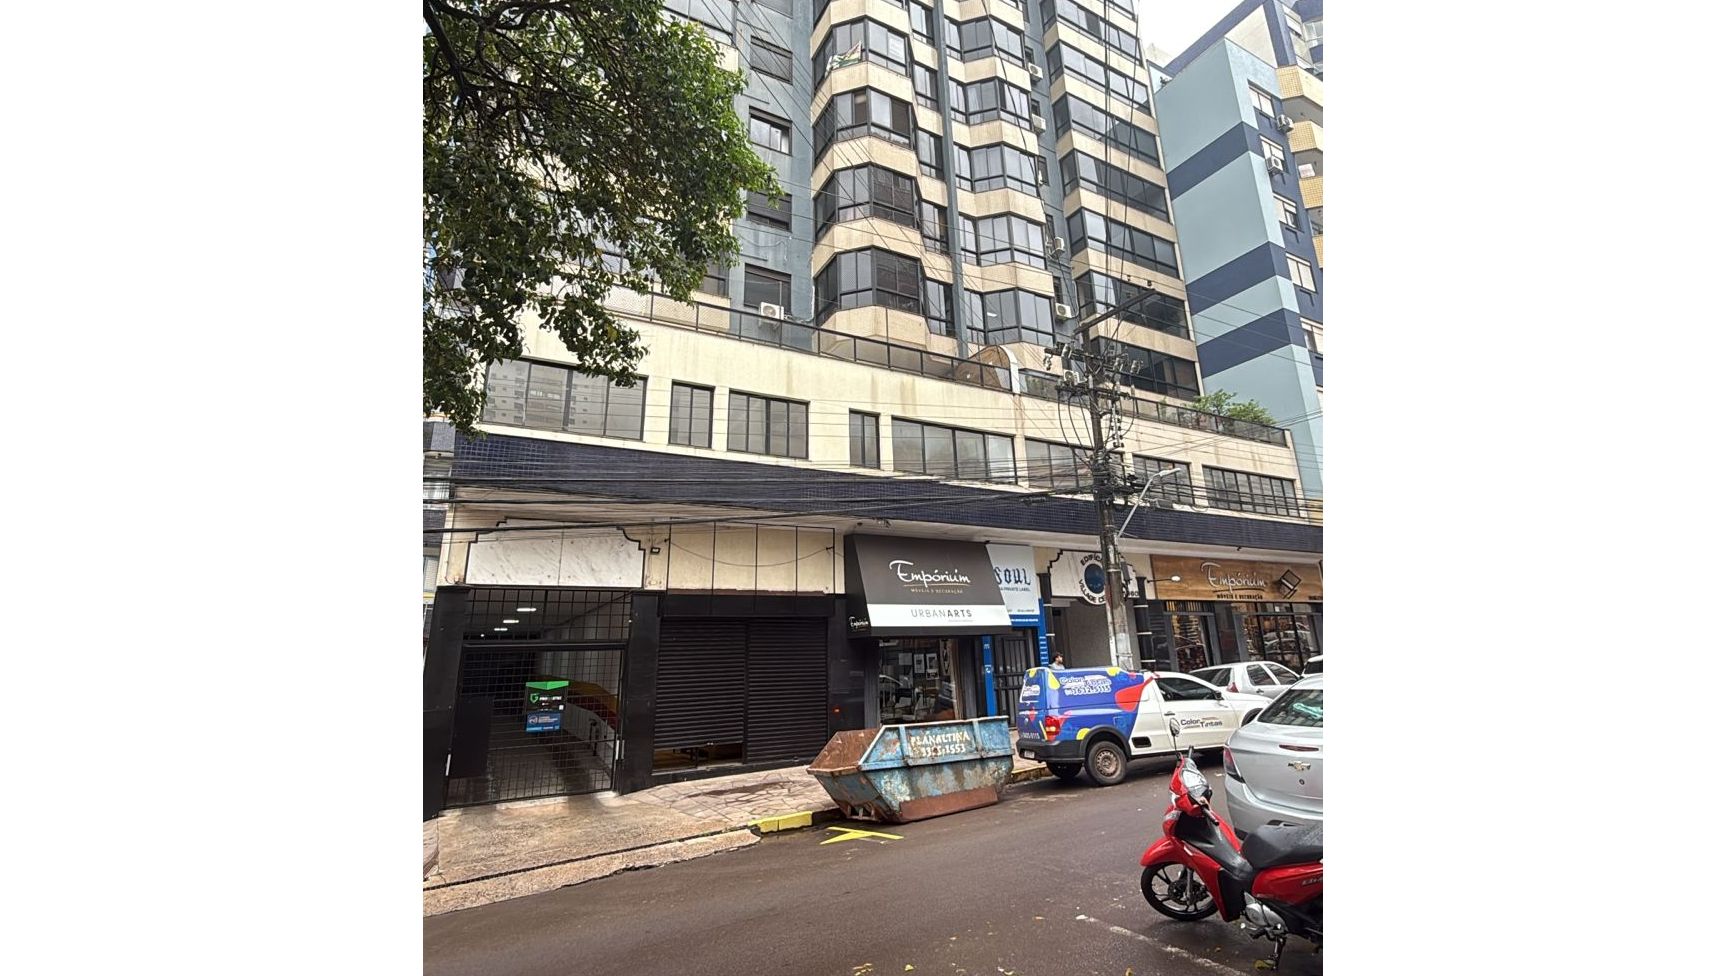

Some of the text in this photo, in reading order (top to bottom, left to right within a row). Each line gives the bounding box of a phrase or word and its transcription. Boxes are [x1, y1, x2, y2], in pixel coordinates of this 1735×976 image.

[994, 566, 1031, 585] SOUL
[1079, 579, 1097, 603] VILLAGE
[1200, 720, 1222, 728] Tintas
[911, 731, 970, 747] PLANALTINA
